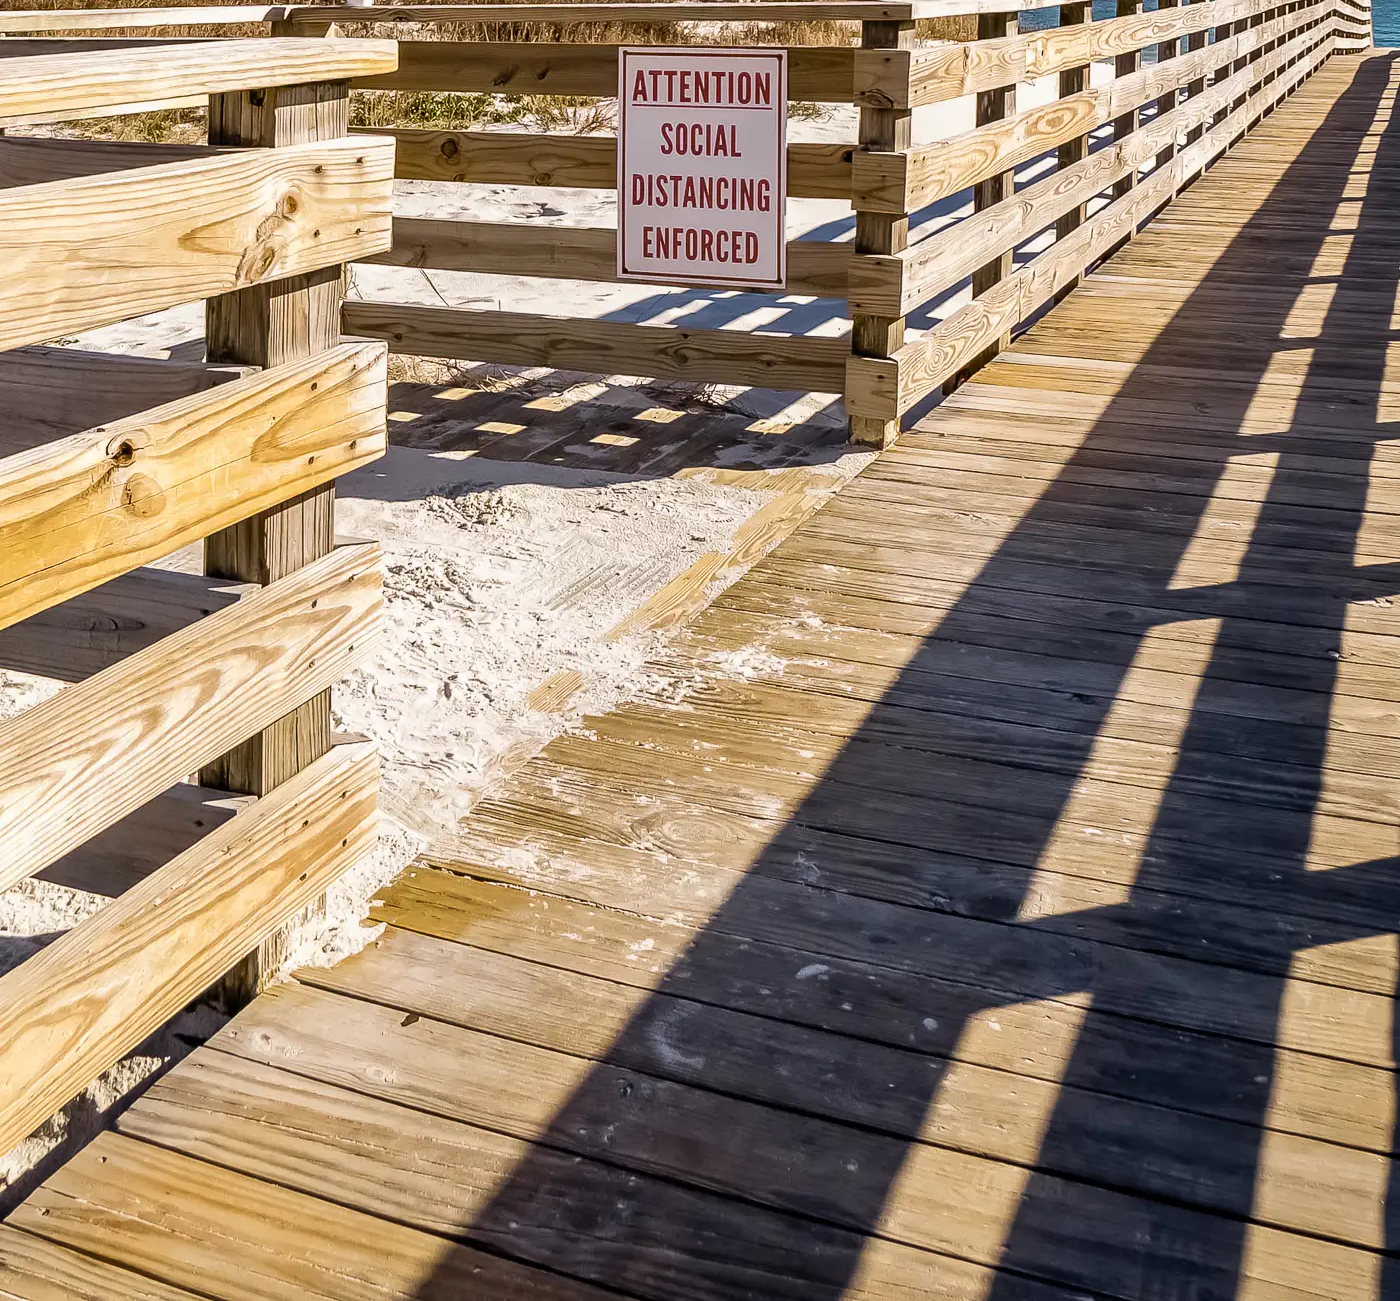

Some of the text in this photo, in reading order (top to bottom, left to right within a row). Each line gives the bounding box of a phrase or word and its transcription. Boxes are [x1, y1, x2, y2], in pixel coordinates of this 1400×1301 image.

[632, 70, 771, 105] ATTENTION
[660, 123, 742, 157] SOCIAL
[632, 174, 771, 212] DISTANCING
[642, 227, 759, 264] ENFORCED
